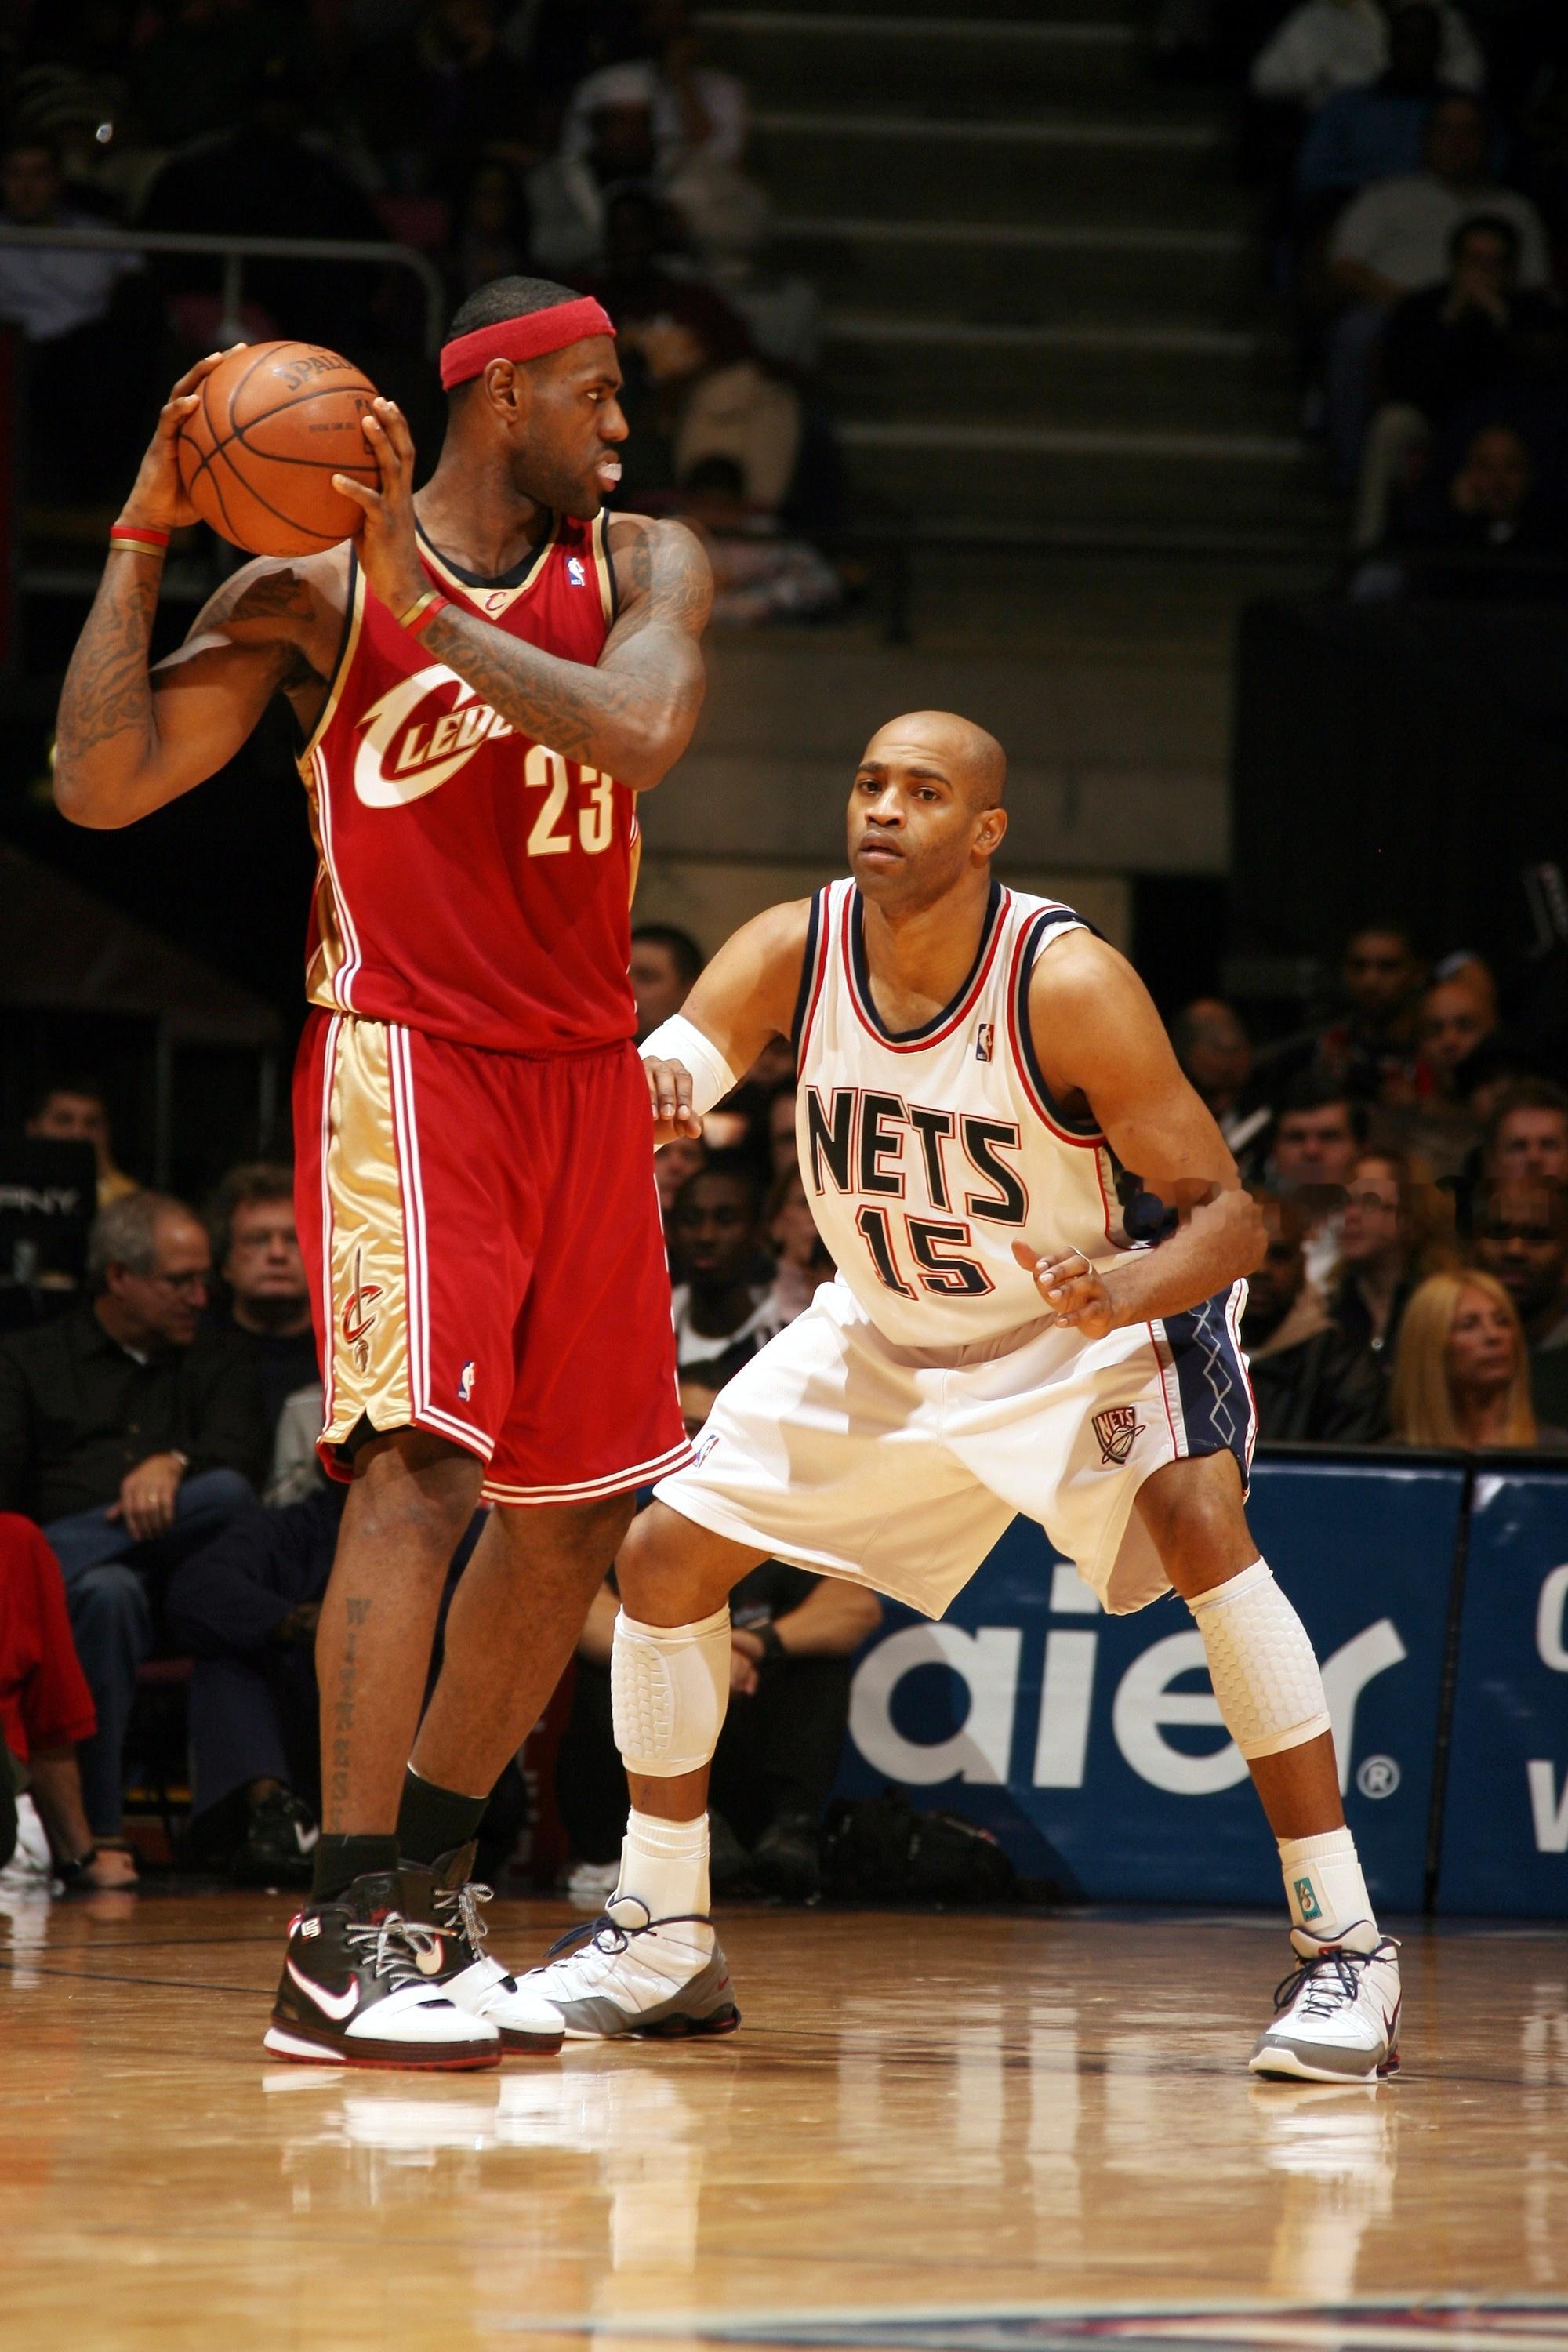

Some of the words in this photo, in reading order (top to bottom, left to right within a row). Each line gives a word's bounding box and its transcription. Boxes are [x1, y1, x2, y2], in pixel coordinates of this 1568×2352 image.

[273, 354, 355, 391] SPALD
[524, 743, 613, 858] 23
[805, 1085, 1029, 1227] NETS
[855, 1203, 996, 1301] 15
[1097, 1408, 1134, 1446] NETS
